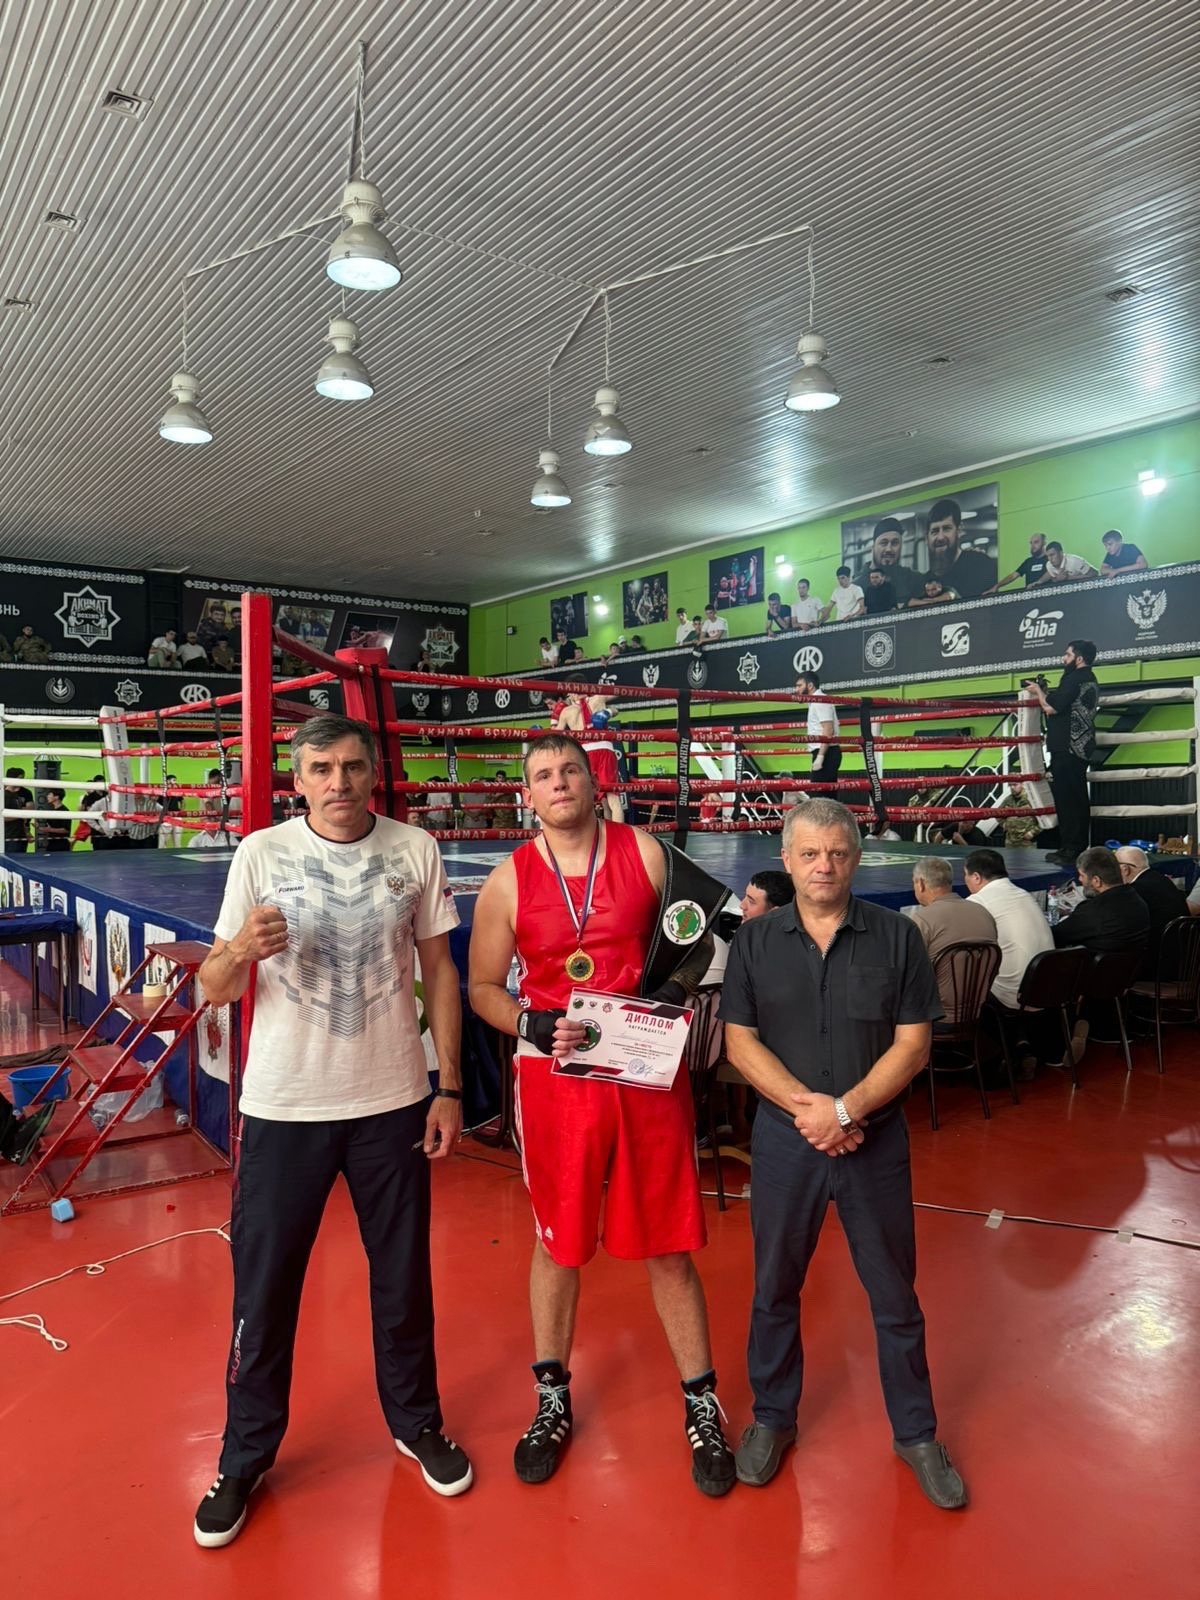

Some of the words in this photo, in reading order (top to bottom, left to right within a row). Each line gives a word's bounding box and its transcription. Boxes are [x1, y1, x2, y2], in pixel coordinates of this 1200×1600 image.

[0, 604, 20, 616] НЬ
[70, 598, 108, 614] AKHMAT
[1025, 620, 1057, 639] aiba
[557, 682, 602, 693] AKHMAT
[614, 688, 652, 697] BOXING
[419, 728, 472, 736] AKHMAT
[484, 728, 528, 738] BOXING
[563, 731, 606, 740] KHMAT
[617, 733, 655, 741] BOXING
[679, 738, 690, 775] AKHMAT
[434, 830, 488, 839] AKHMAT
[641, 824, 671, 833] OXING
[625, 1012, 675, 1030] ДИПЛОМ
